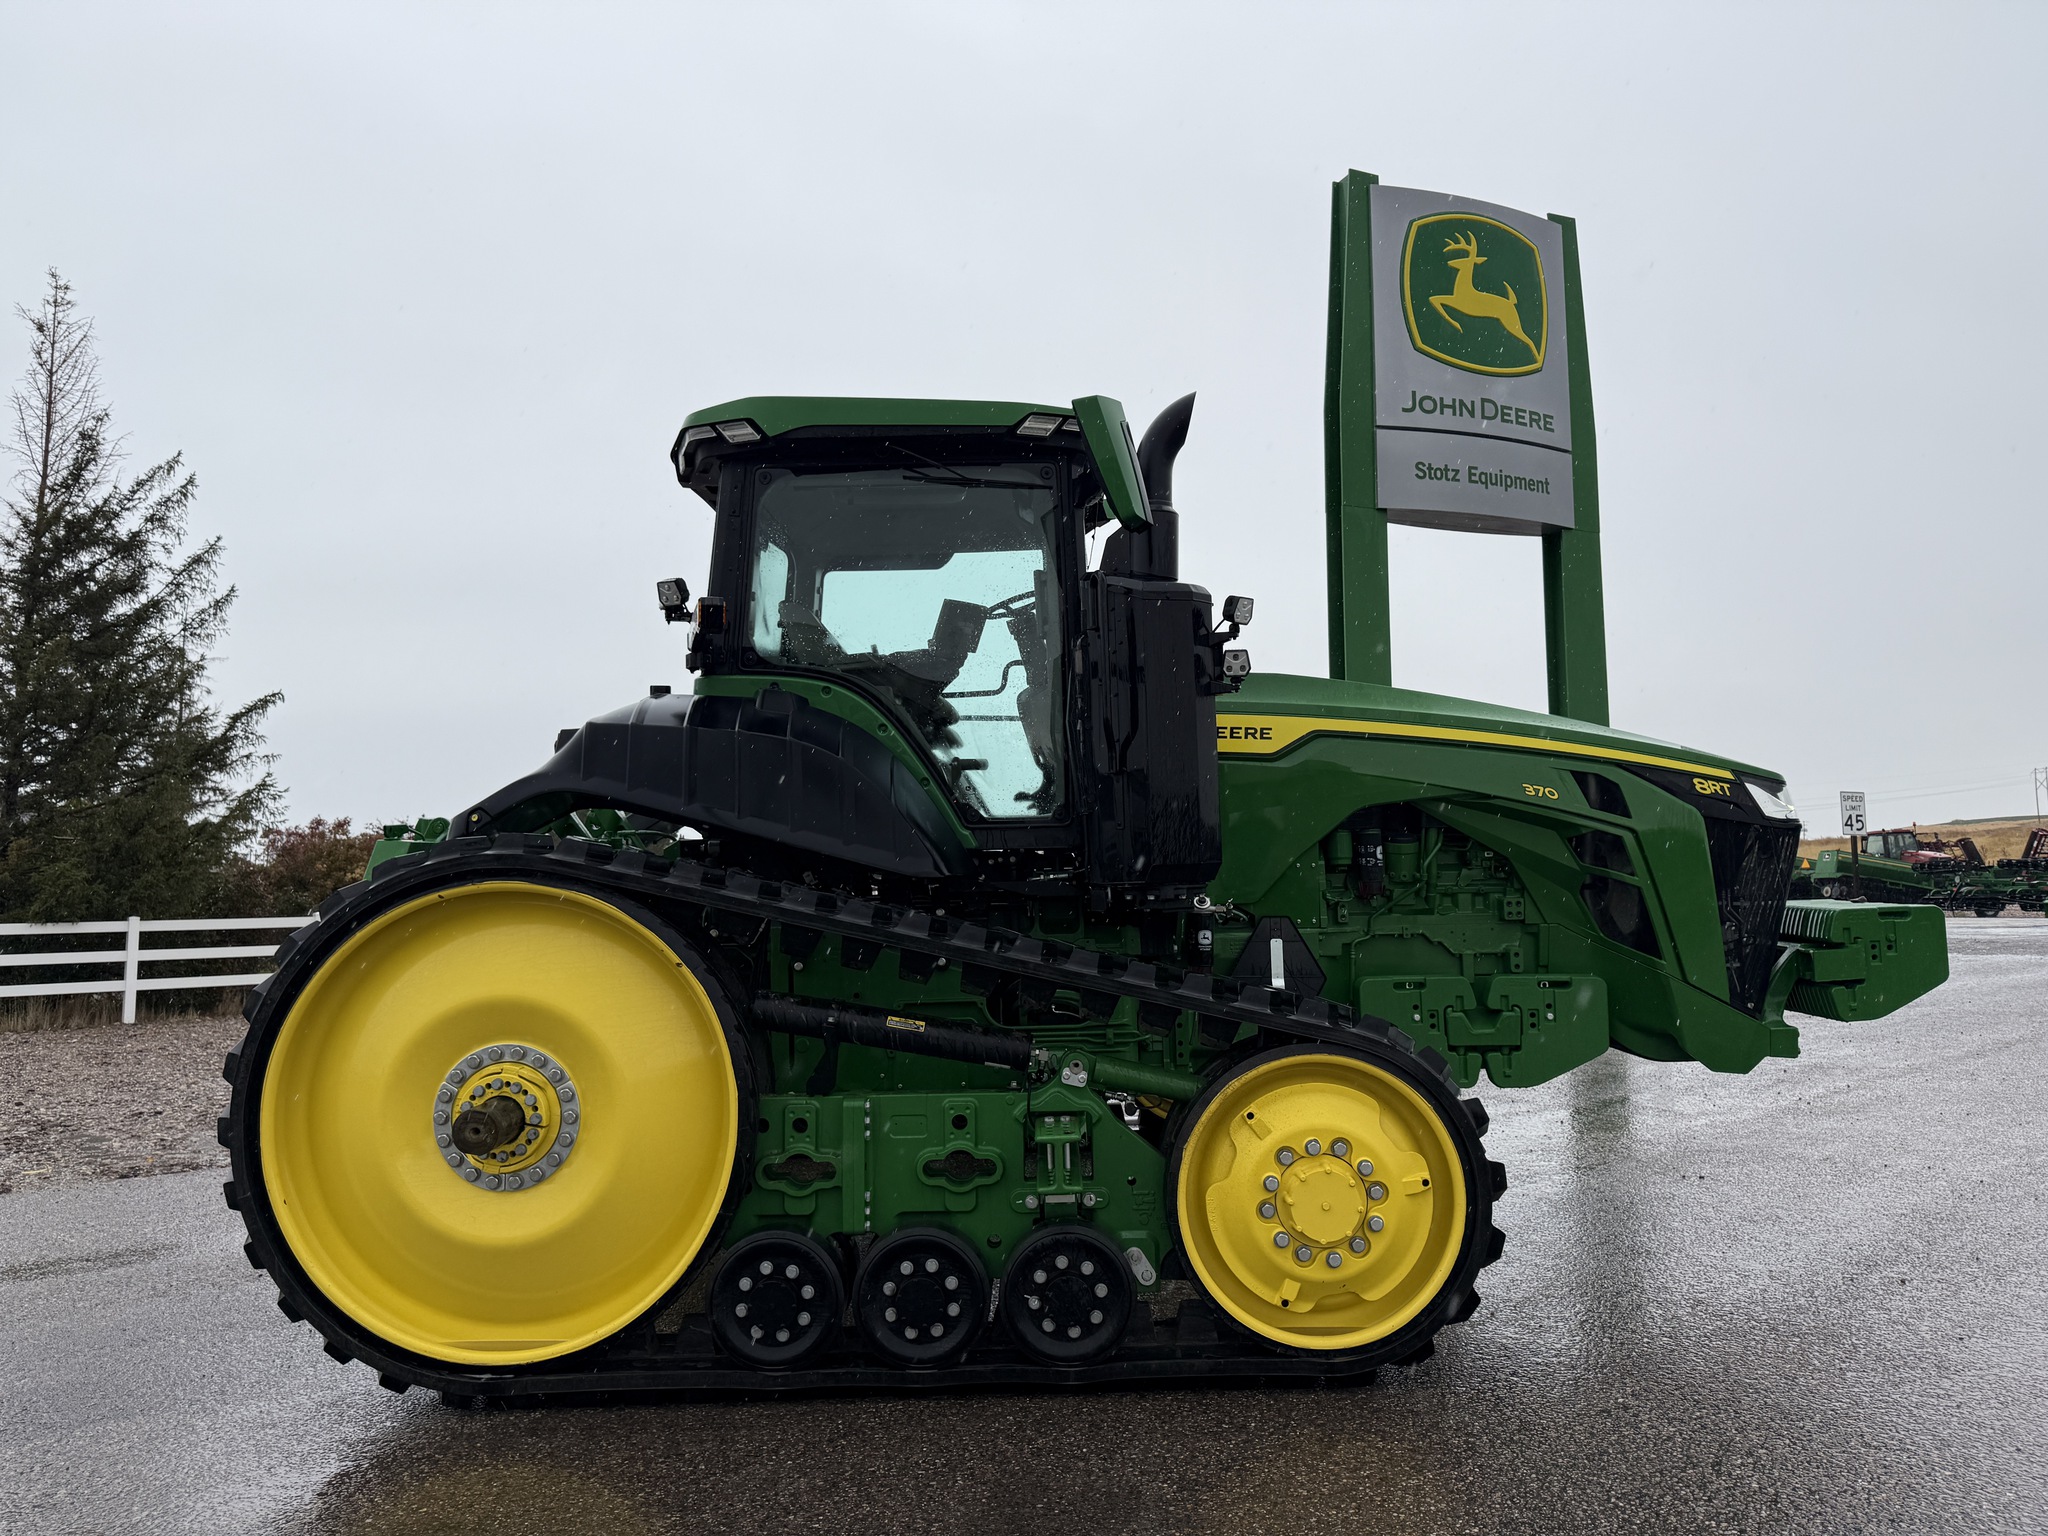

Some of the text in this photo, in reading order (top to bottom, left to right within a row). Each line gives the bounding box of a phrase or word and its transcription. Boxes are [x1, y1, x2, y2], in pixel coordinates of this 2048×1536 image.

[1401, 390, 1555, 433] JOHN DEERE
[1414, 461, 1550, 495] Stotz Equipment
[1521, 783, 1559, 800] 370
[1692, 777, 1731, 797] 8RT
[1844, 813, 1865, 831] 45
